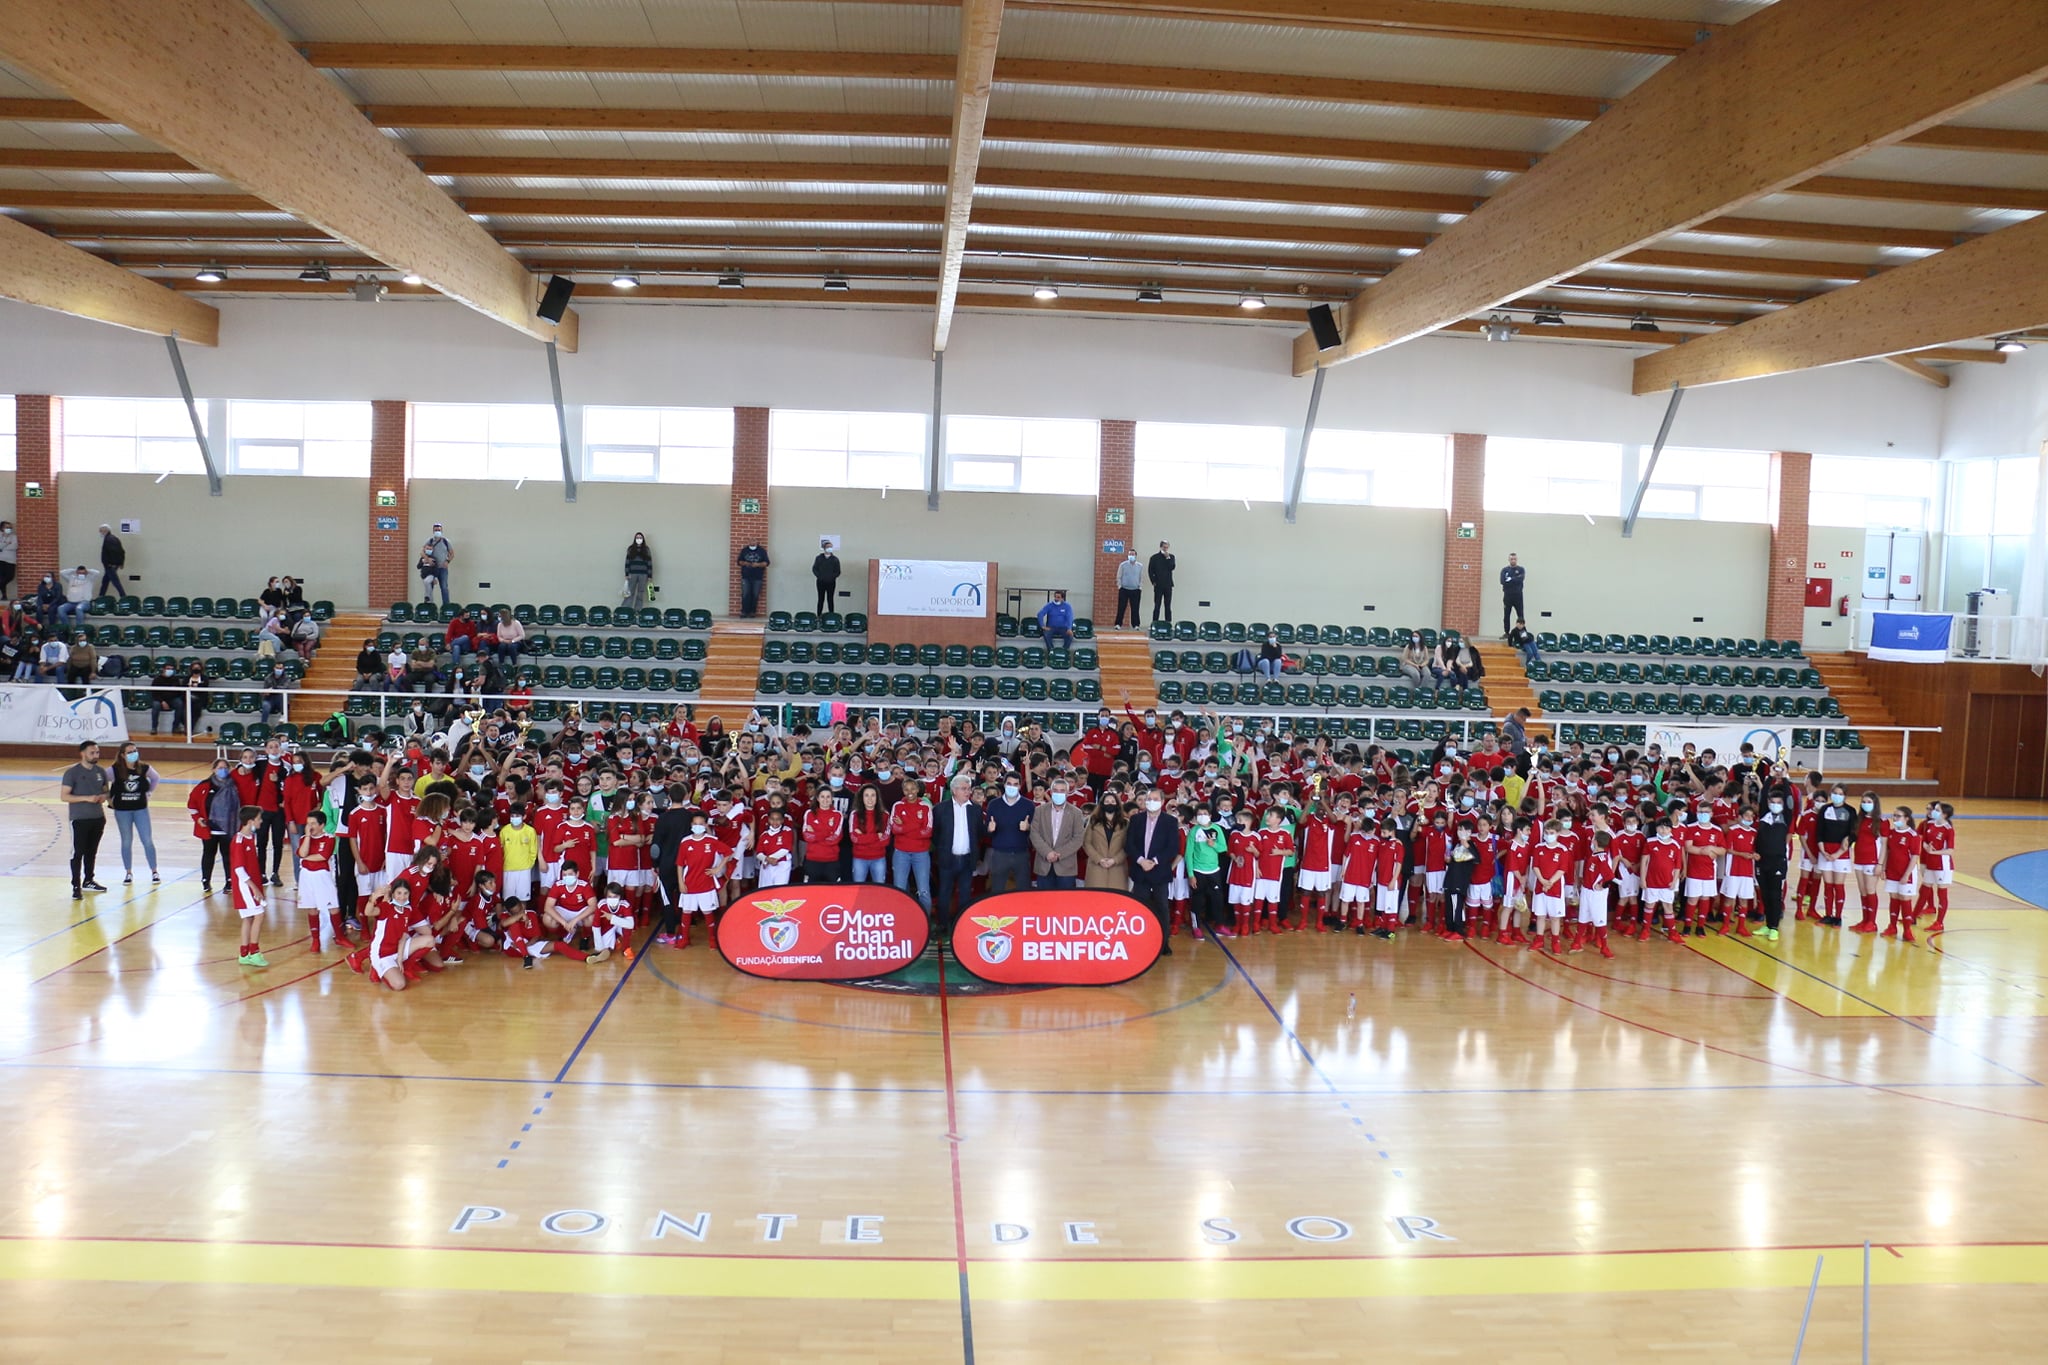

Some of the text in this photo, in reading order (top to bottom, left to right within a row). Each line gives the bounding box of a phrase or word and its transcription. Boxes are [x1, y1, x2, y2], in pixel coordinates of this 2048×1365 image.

[930, 597, 976, 606] DESPORTO
[37, 714, 109, 730] DESPORTO
[843, 910, 895, 927] More
[1022, 911, 1145, 940] FUNDAÇÃO
[849, 928, 894, 944] than
[835, 940, 912, 961] football
[1023, 941, 1129, 961] BENFICA
[448, 1205, 1455, 1245] PONTE DE SOR
